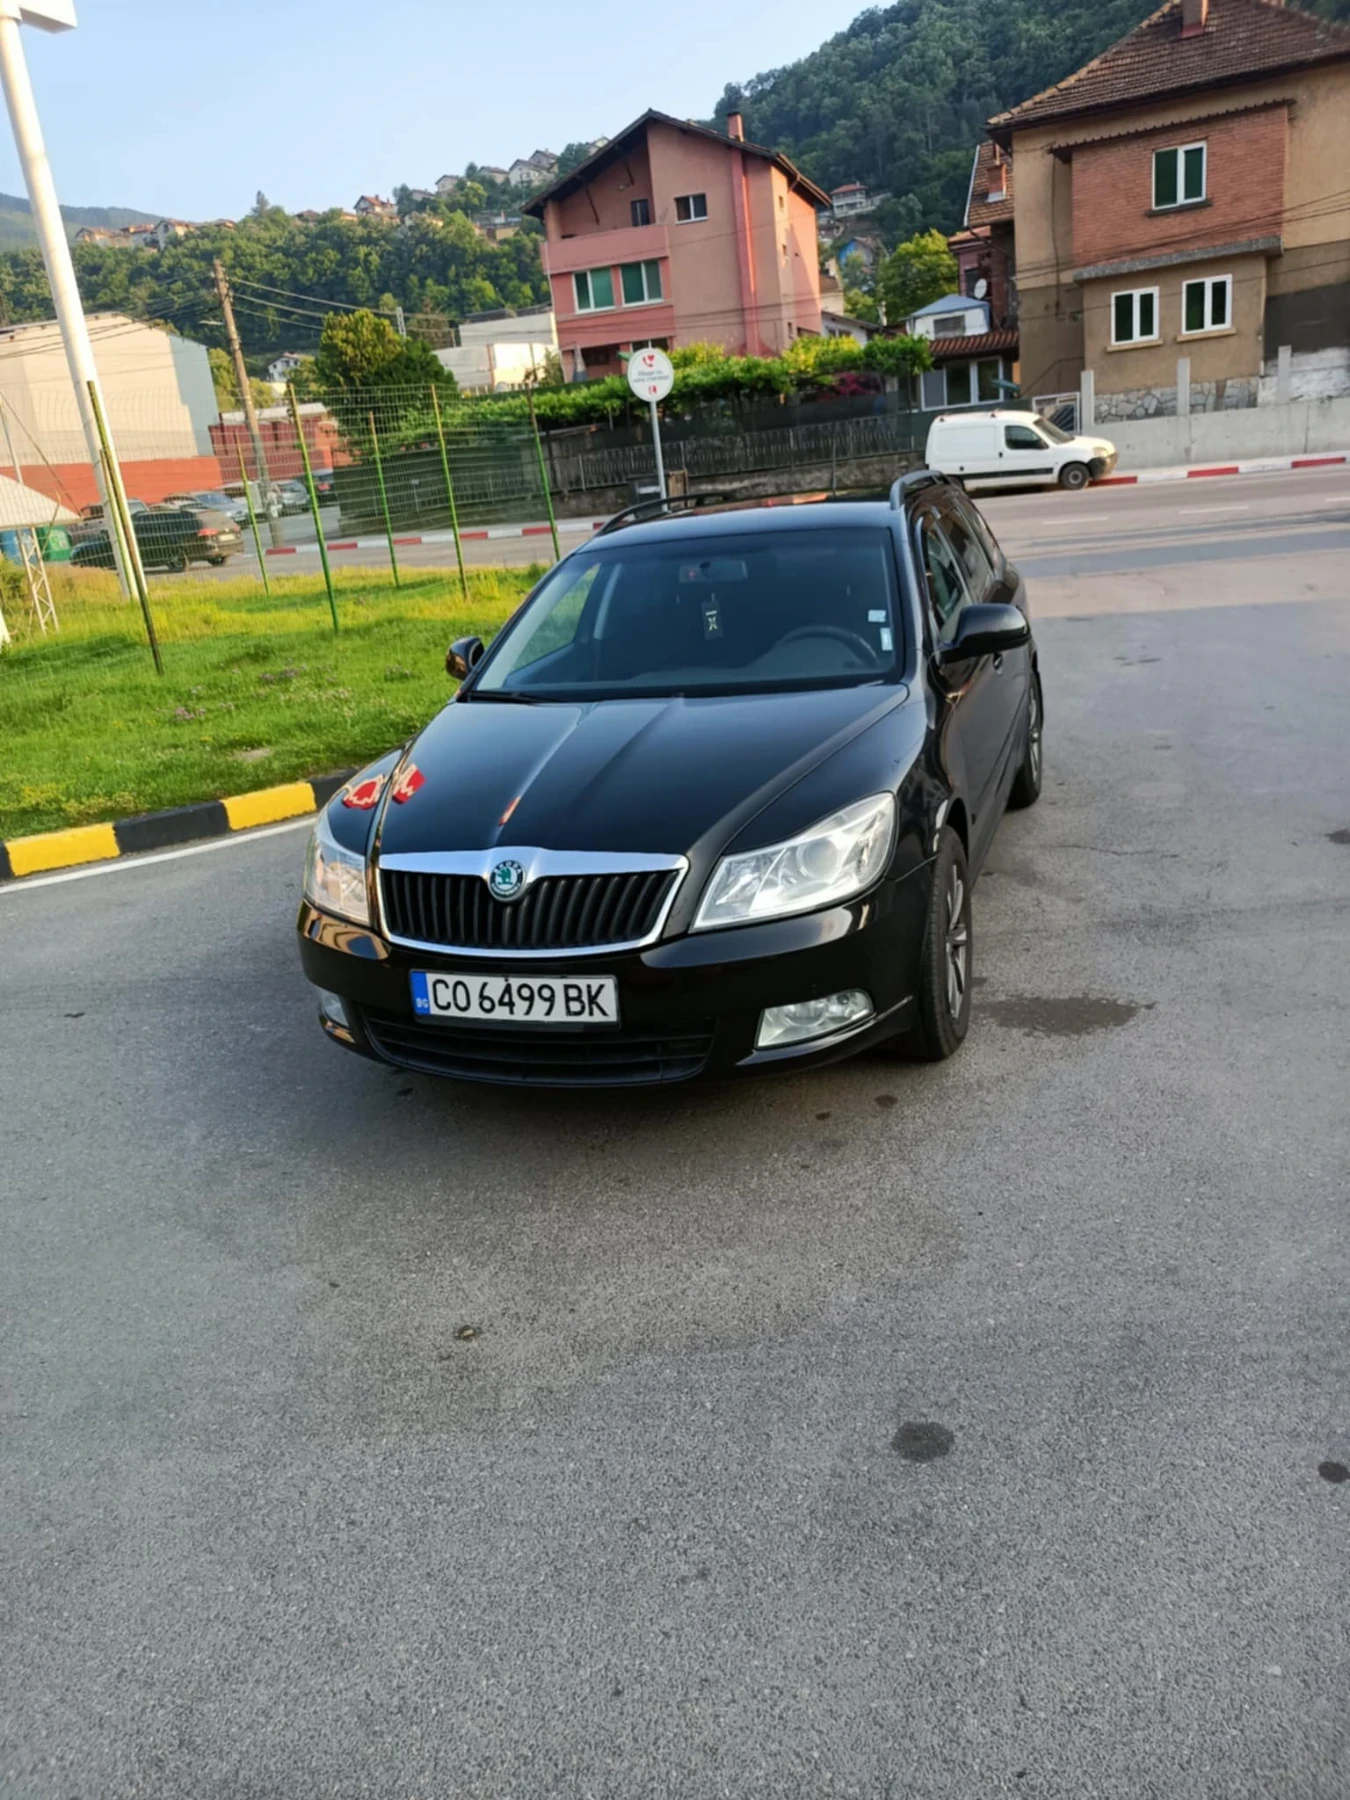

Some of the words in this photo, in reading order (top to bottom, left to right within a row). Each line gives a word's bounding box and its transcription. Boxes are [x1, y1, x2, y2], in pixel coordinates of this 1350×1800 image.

[416, 997, 429, 1008] BG
[432, 978, 471, 1012] CO
[478, 981, 556, 1016] 6499
[563, 983, 610, 1017] BK
